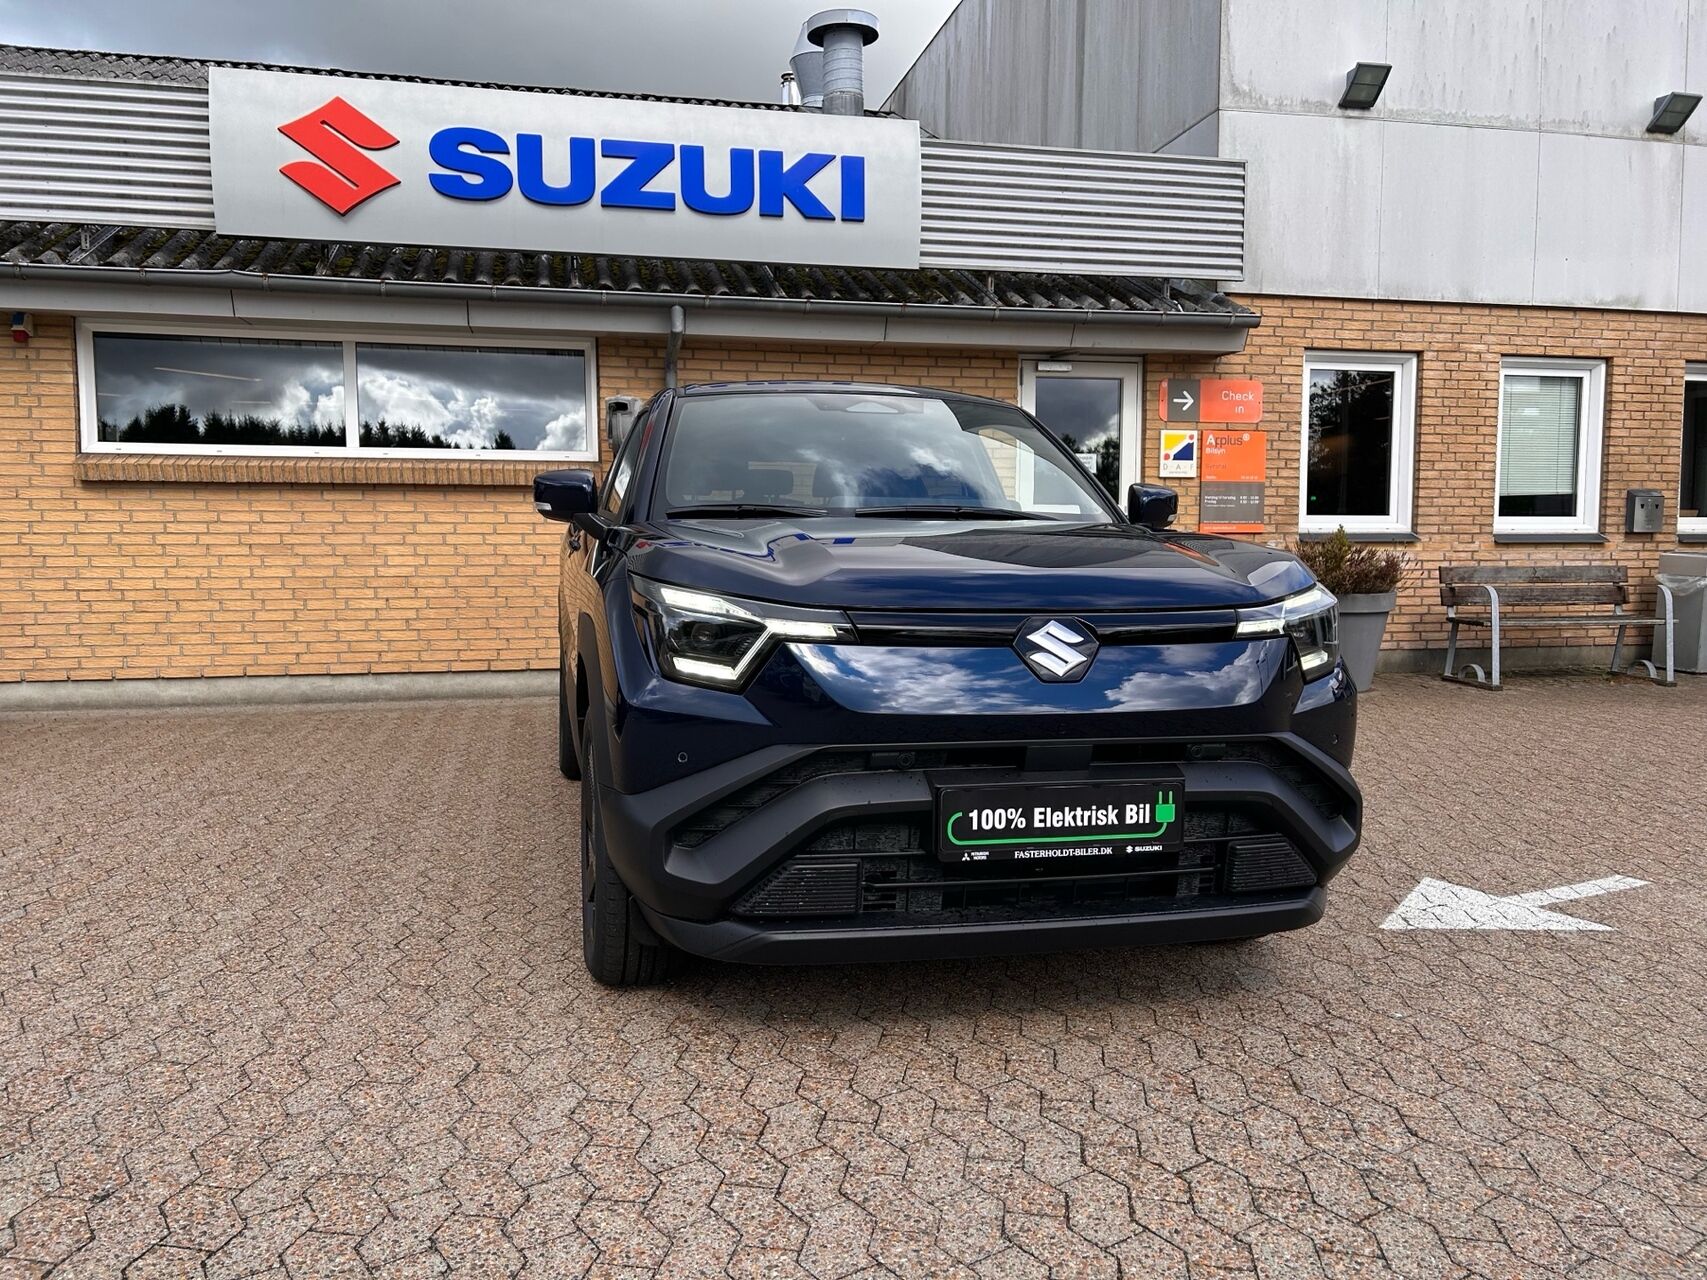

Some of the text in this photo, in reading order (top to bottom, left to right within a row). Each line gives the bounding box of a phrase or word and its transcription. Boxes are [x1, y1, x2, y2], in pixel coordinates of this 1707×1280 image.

[428, 126, 865, 221] SUZUKI
[1221, 390, 1254, 401] Check
[1235, 405, 1245, 414] in
[968, 803, 1150, 830] 100% Elektrisk Bil
[1014, 846, 1113, 859] FASTERHOLDT-BILER.DK
